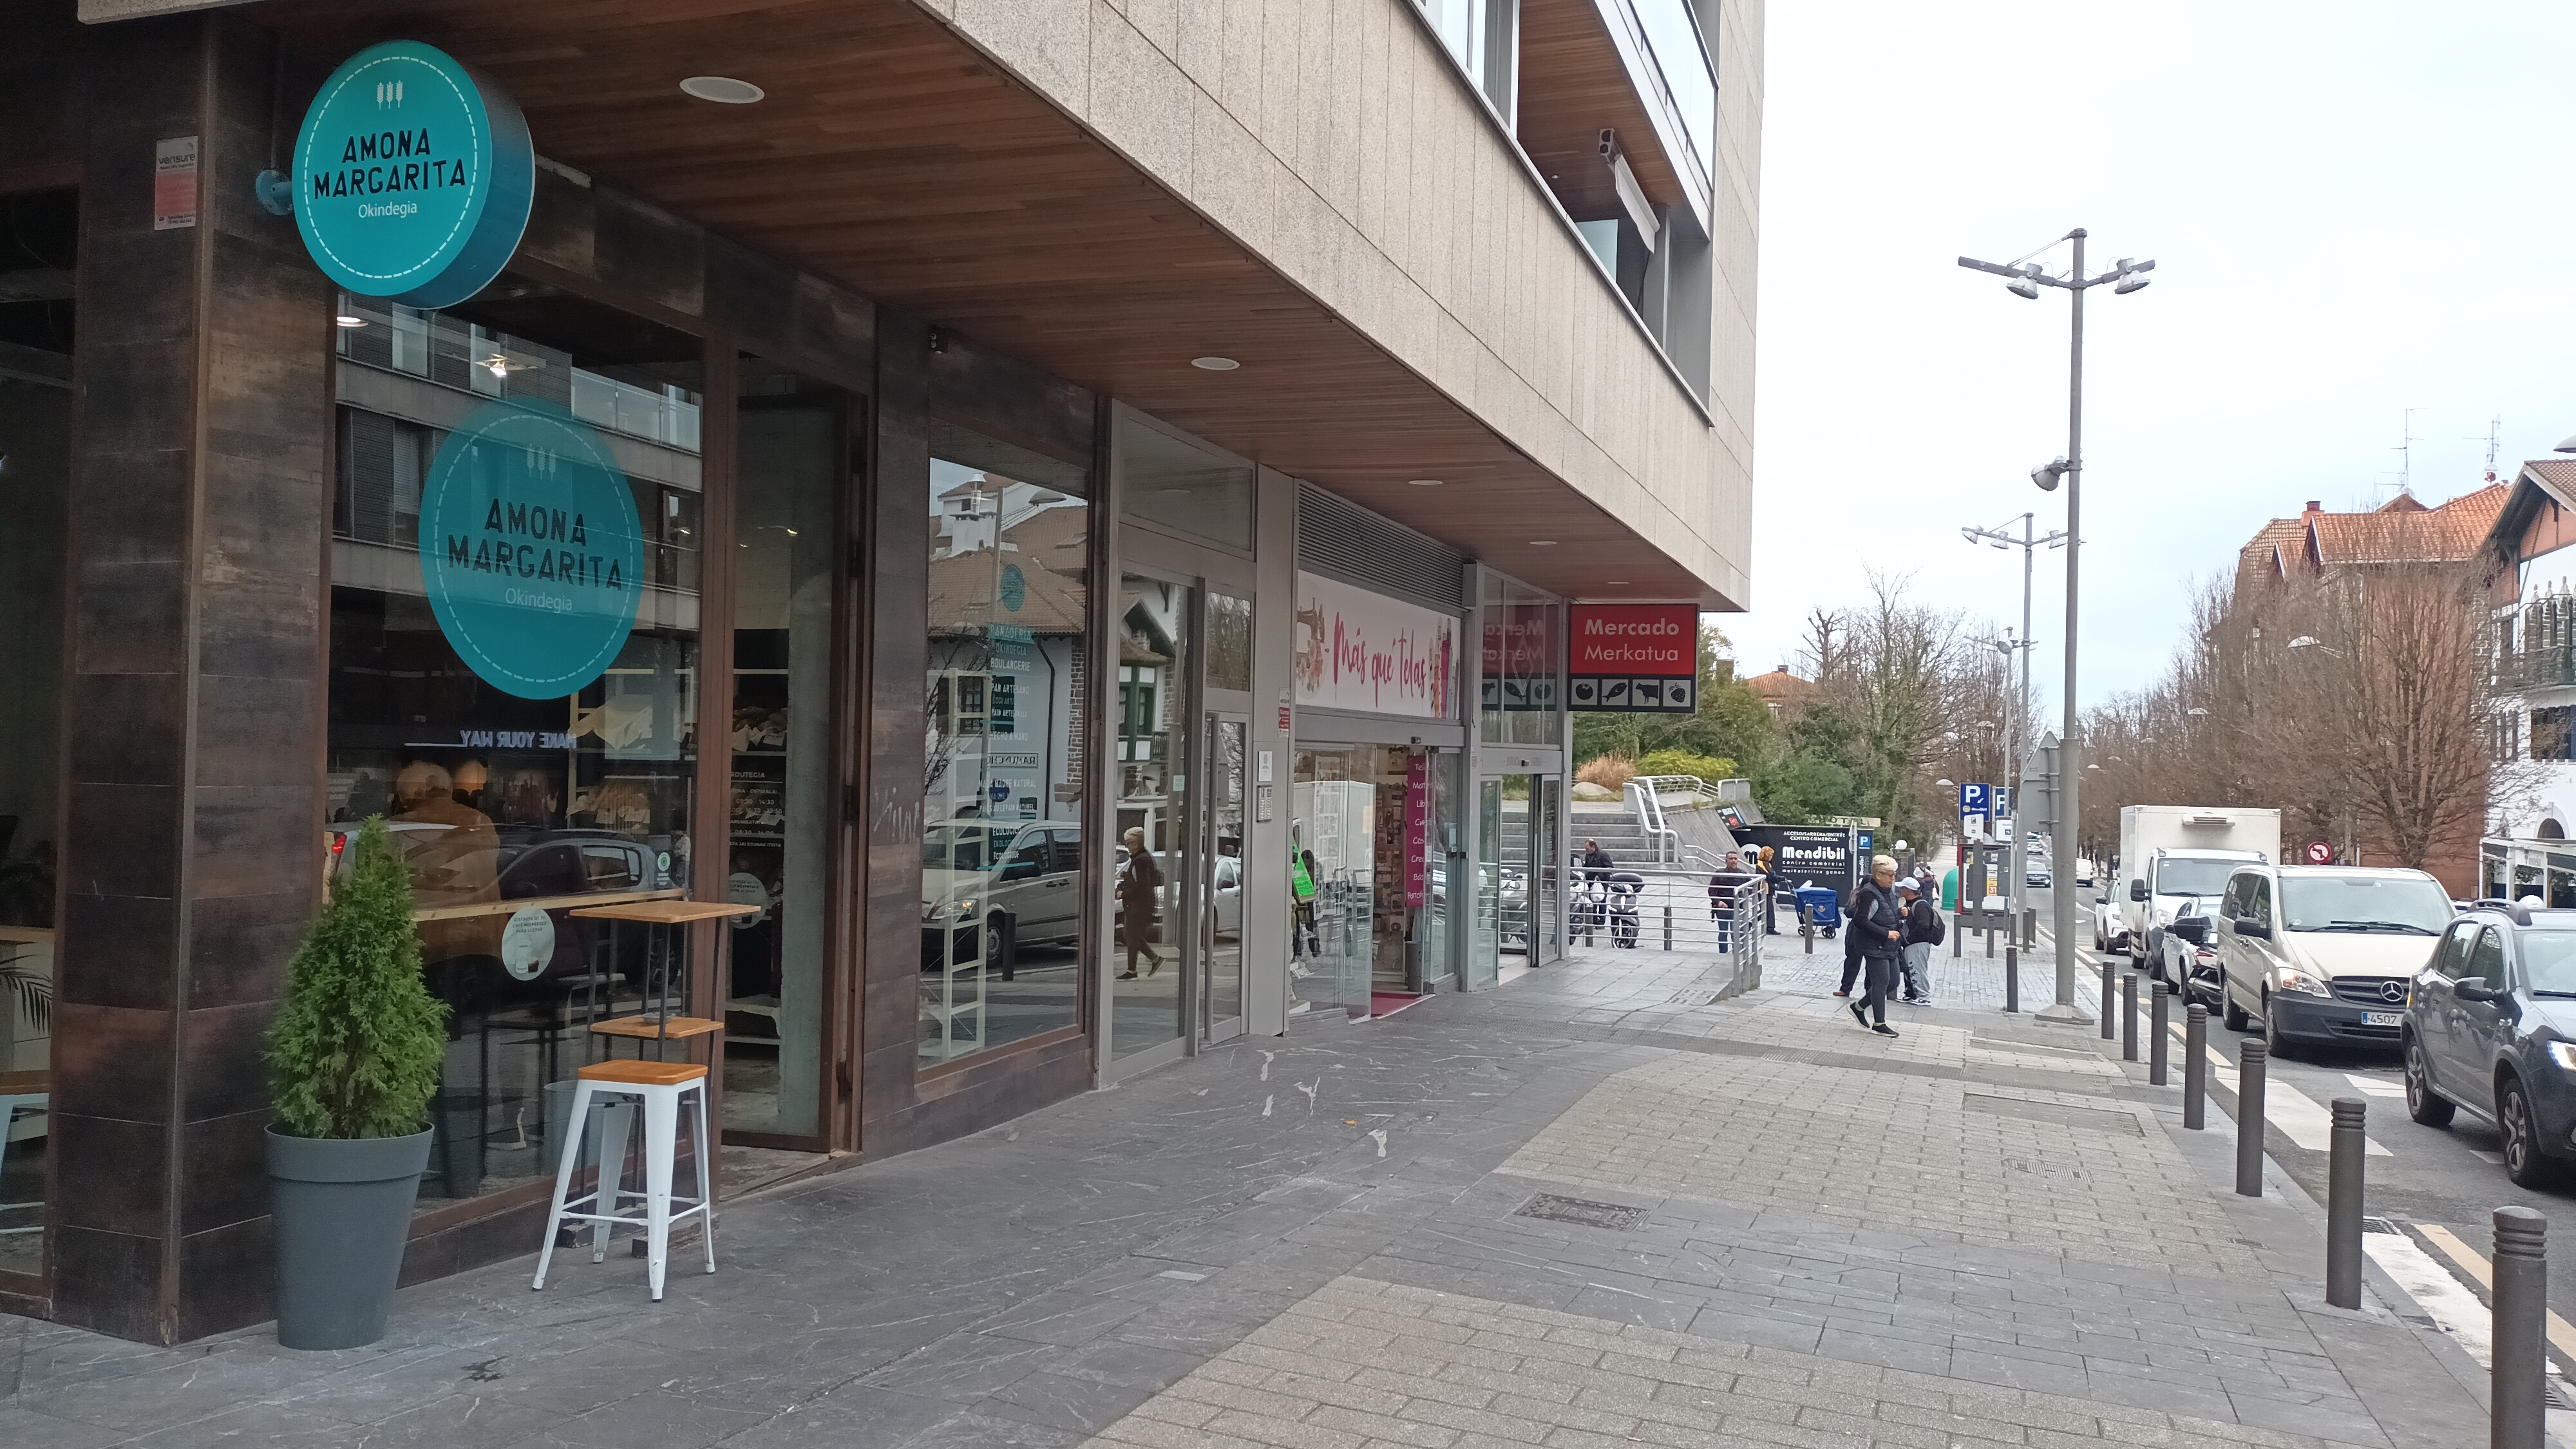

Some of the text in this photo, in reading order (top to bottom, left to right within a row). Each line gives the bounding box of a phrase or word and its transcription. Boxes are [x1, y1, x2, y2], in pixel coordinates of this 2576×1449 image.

[341, 128, 431, 164] AMONA
[314, 158, 466, 200] MARGARITA
[358, 201, 417, 218] Okindegia
[484, 498, 586, 547] AMONA
[448, 535, 622, 591] MARGARITA
[506, 587, 573, 614] Okindegia
[1584, 618, 1680, 637] Mercado
[1333, 611, 1367, 685] Más
[1584, 643, 1679, 662] Merkatua
[990, 657, 1030, 672] BOULANGERIE
[1965, 785, 1981, 803] P
[1860, 836, 1868, 846] P
[1782, 846, 1845, 860] Mendibil
